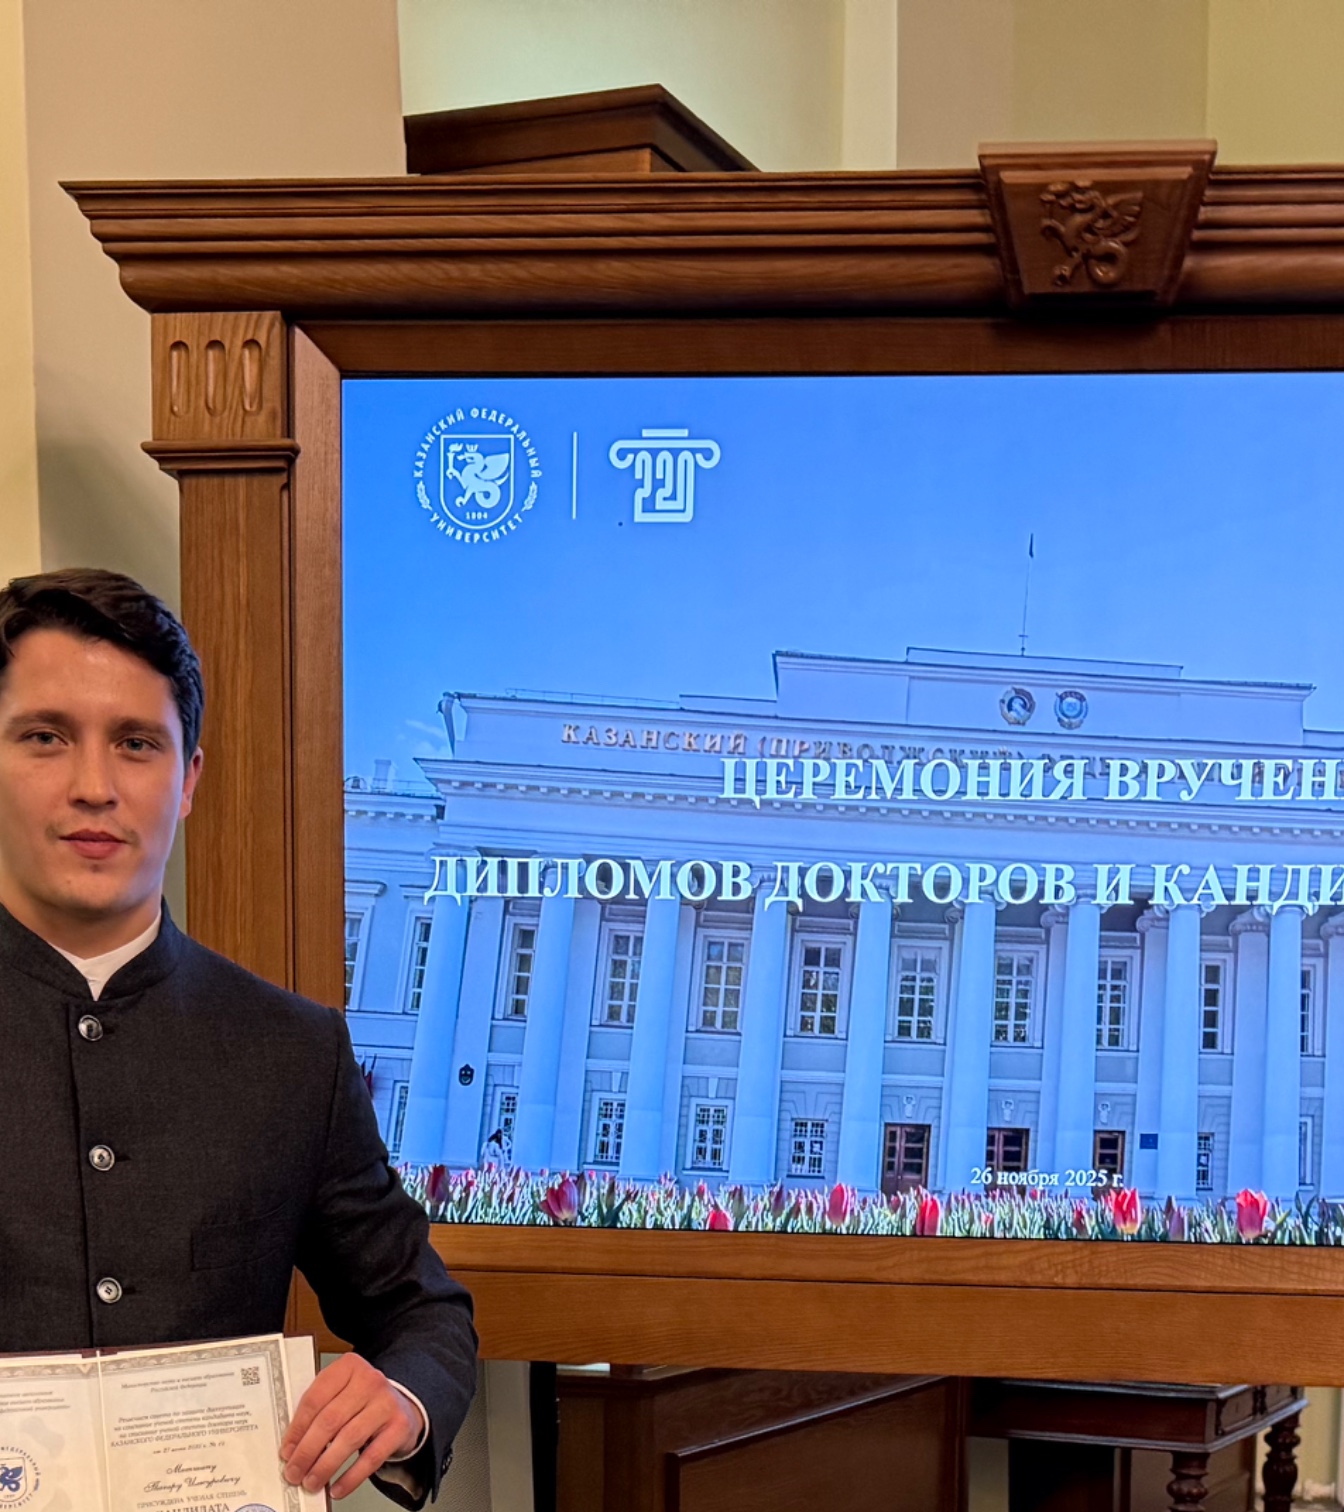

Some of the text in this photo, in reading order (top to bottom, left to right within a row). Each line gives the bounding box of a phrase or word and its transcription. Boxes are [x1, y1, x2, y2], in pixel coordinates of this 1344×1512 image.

[413, 407, 543, 478] КАЗАНСКИЙ ФЕДЕРАЛЬНЫЙ
[430, 512, 524, 544] УНИВЕРСИТЕТ
[561, 723, 747, 755] КАЗАНСКИЙ
[718, 758, 1089, 810] ЦЕРЕМОНИЯ
[423, 856, 754, 906] ДИПЛОМОВ
[763, 861, 1077, 912] ДОКТОРОВ
[1090, 863, 1136, 905] И
[970, 1167, 1124, 1190] 26 ноября 2025 г.
